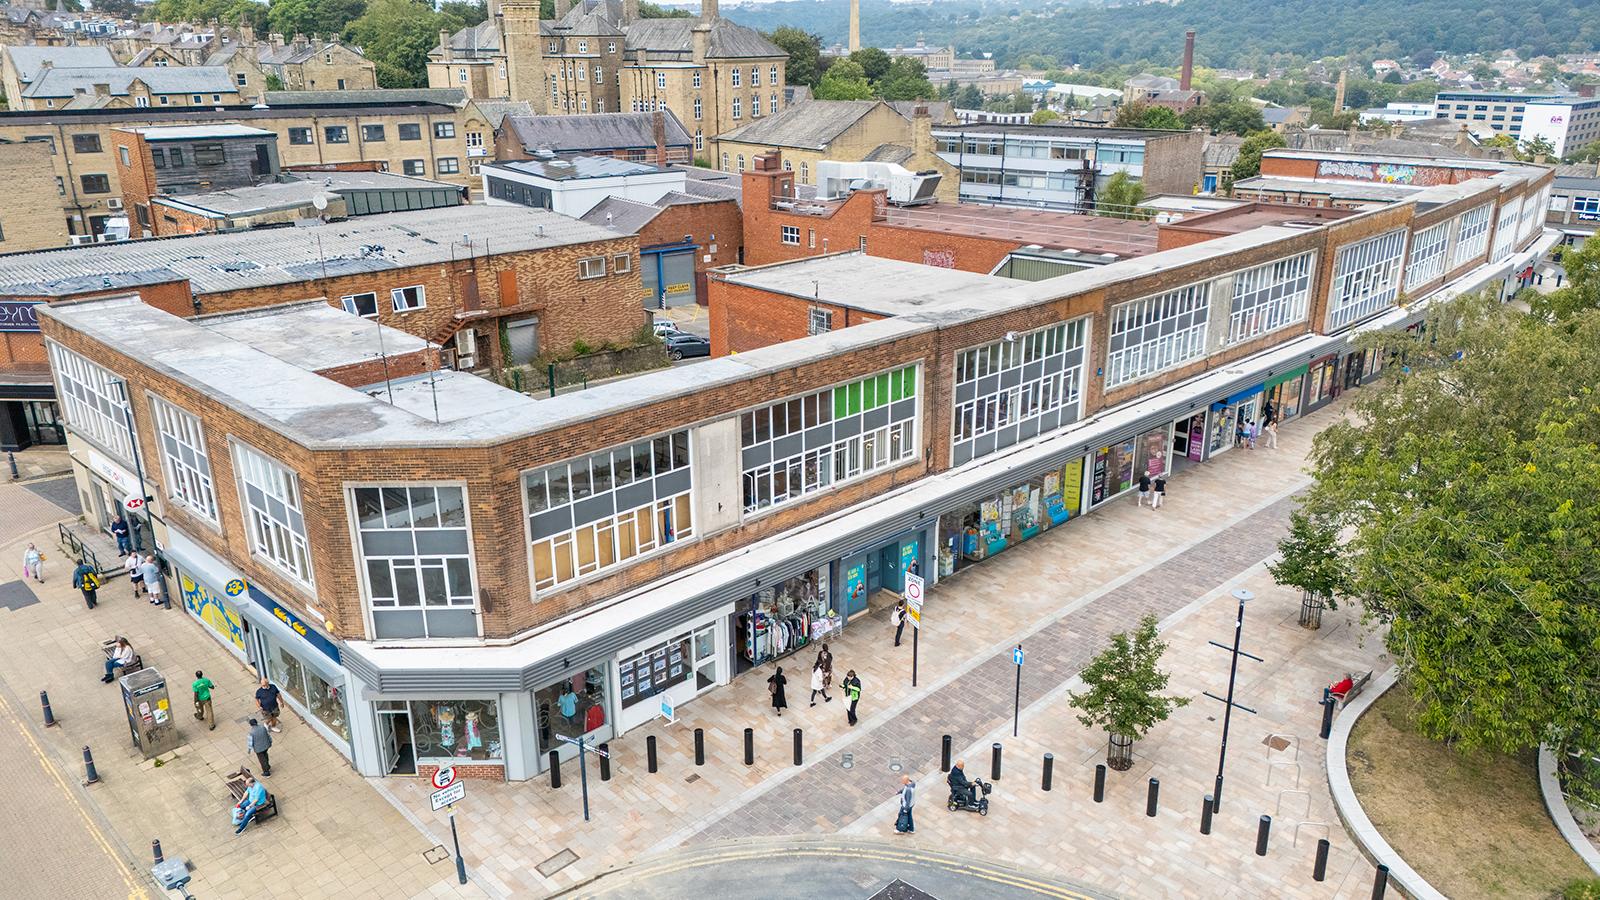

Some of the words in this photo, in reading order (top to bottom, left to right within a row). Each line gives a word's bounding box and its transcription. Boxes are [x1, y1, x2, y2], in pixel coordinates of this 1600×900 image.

[908, 576, 921, 586] ZONE
[442, 784, 462, 795] vehicles
[435, 792, 453, 802] Except
[441, 796, 457, 805] access
